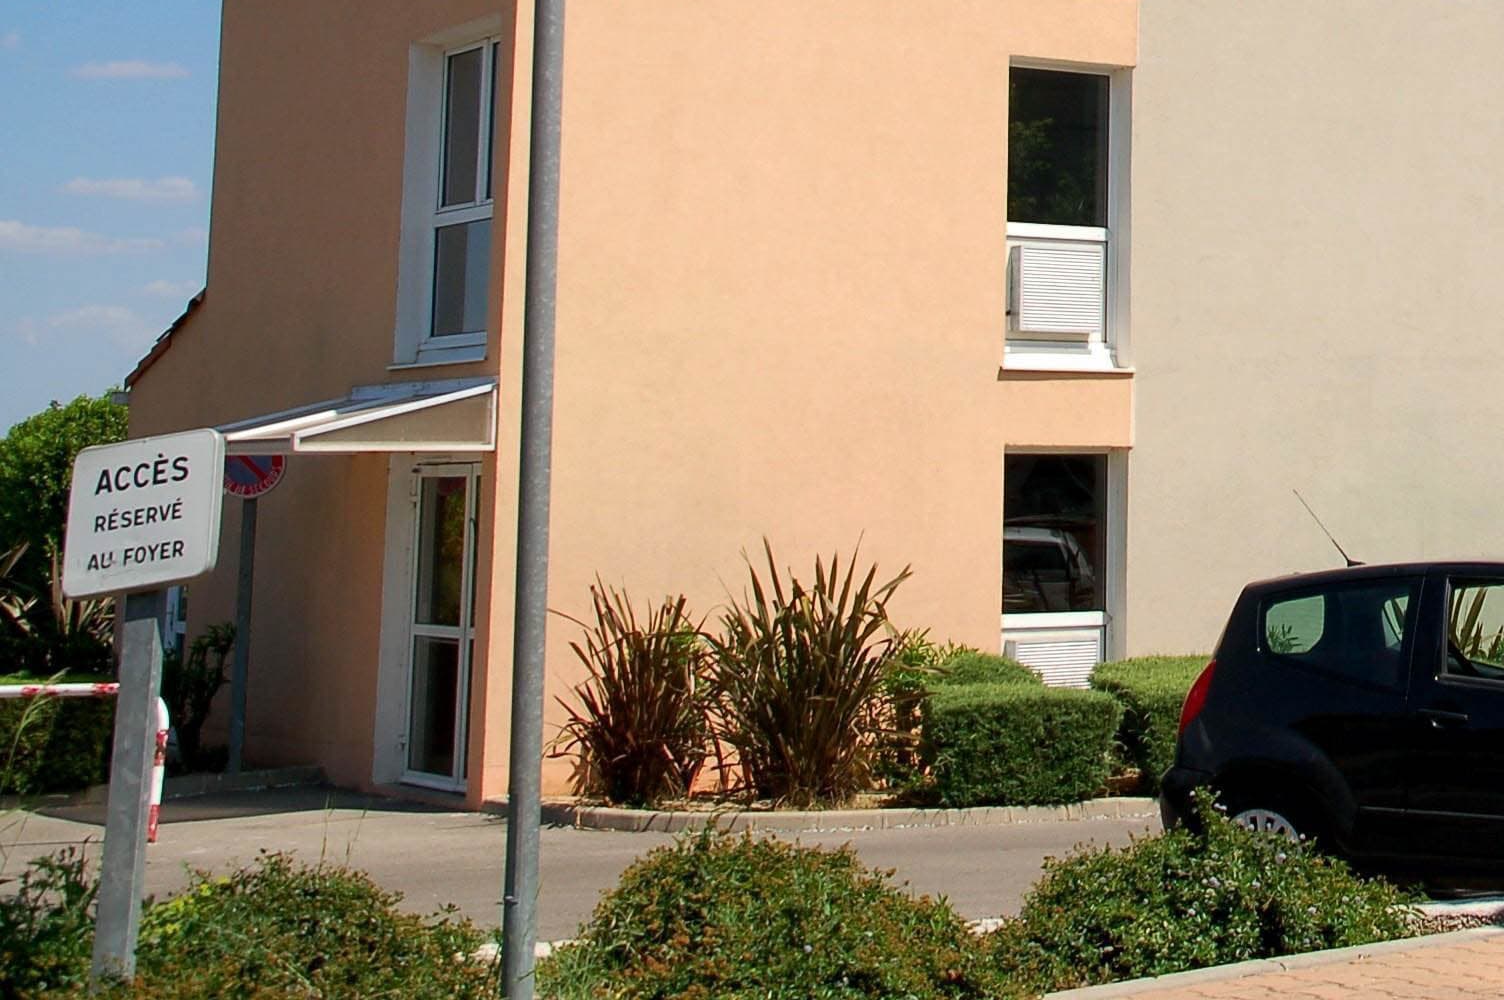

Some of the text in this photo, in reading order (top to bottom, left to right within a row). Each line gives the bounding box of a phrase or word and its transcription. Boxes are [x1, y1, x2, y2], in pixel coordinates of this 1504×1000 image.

[94, 453, 189, 496] ACCÈS
[94, 497, 183, 533] RÉSERVÉ
[87, 540, 185, 571] AU FOYER
